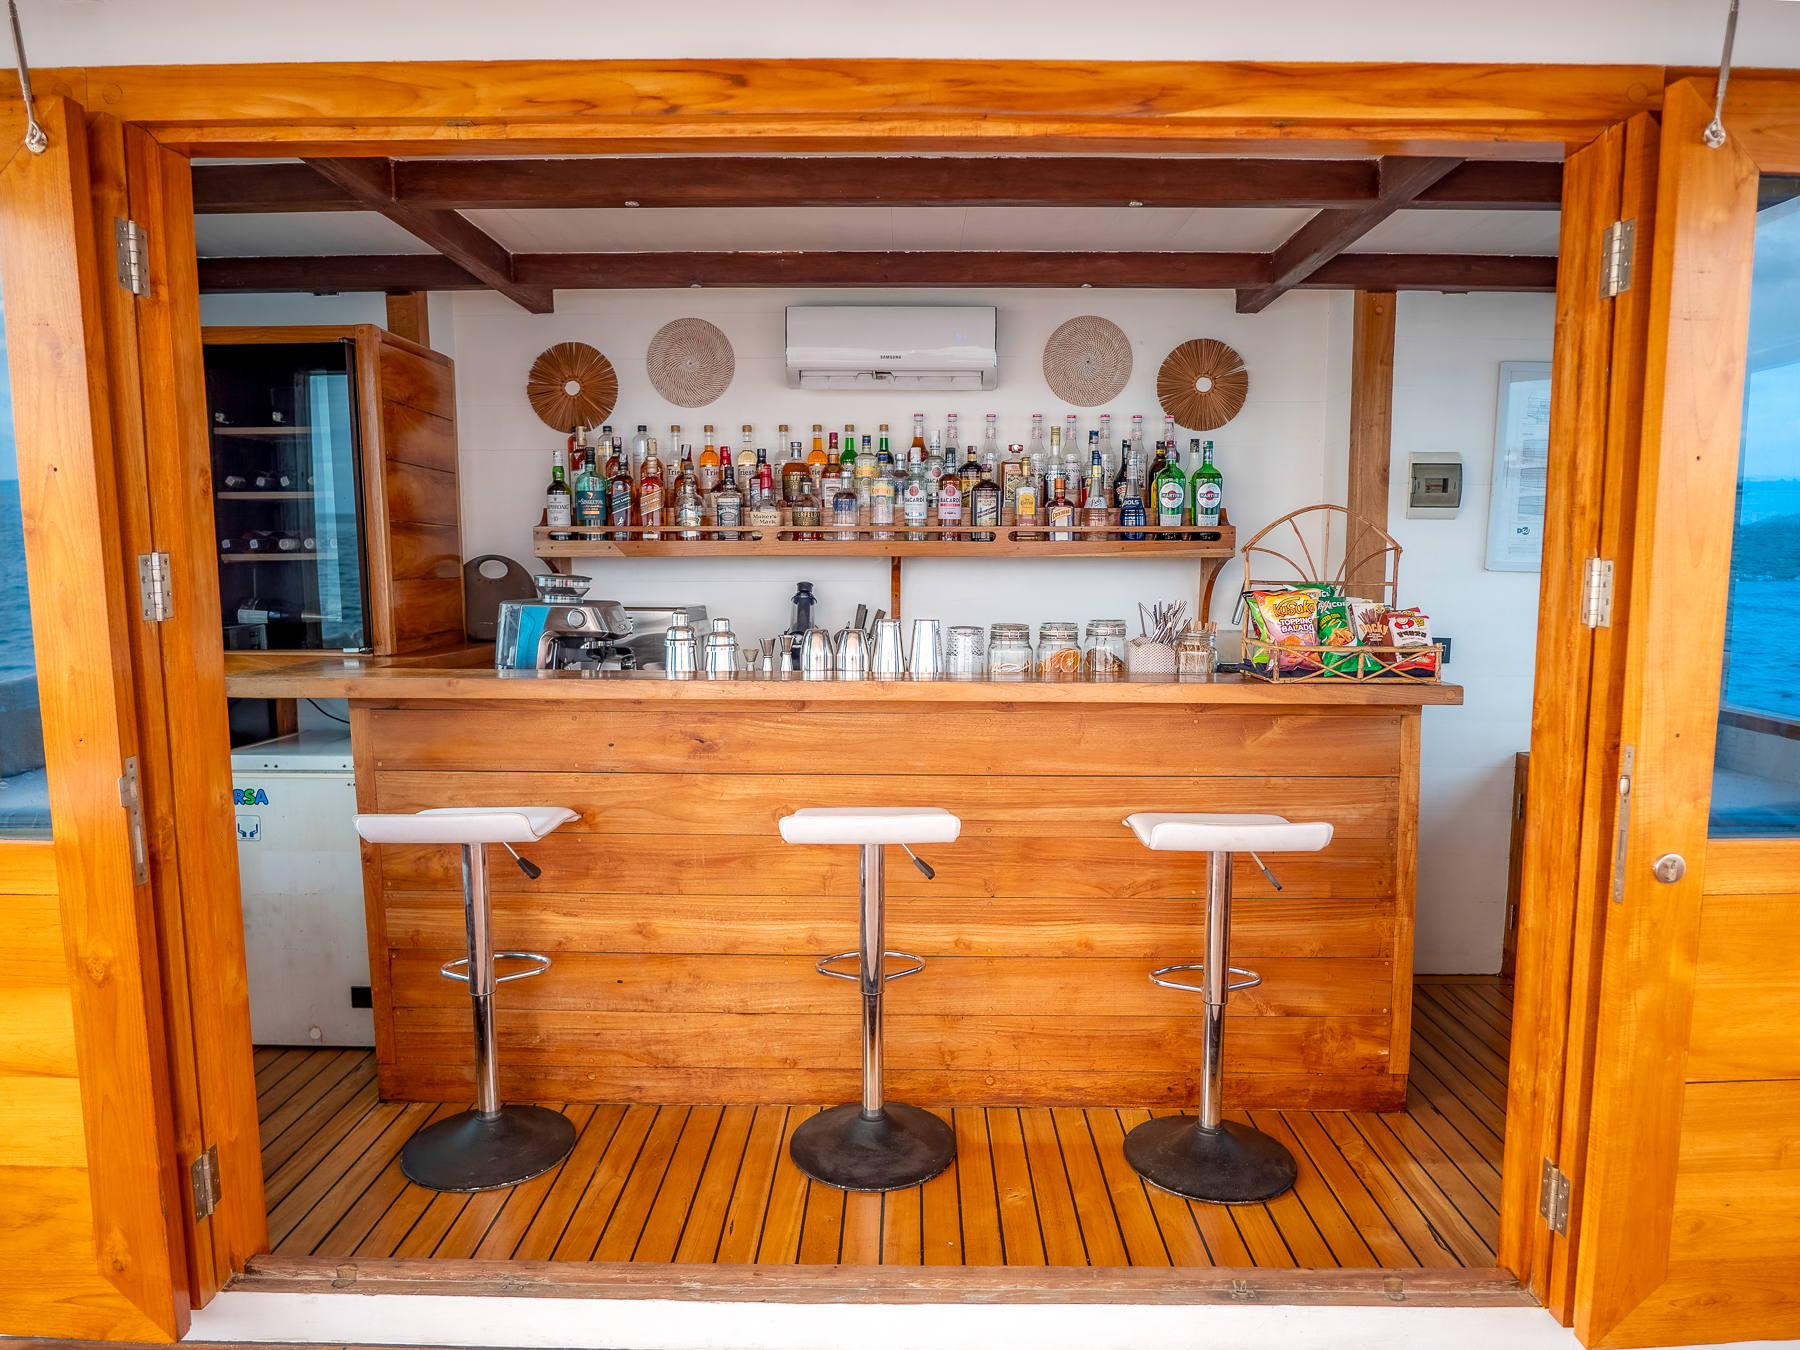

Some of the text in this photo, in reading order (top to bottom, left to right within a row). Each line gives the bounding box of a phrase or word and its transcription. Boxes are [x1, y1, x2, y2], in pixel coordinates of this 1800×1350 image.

[1280, 617, 1313, 627] TOPPING
[1282, 625, 1314, 633] BALADO
[233, 789, 269, 805] RSA
